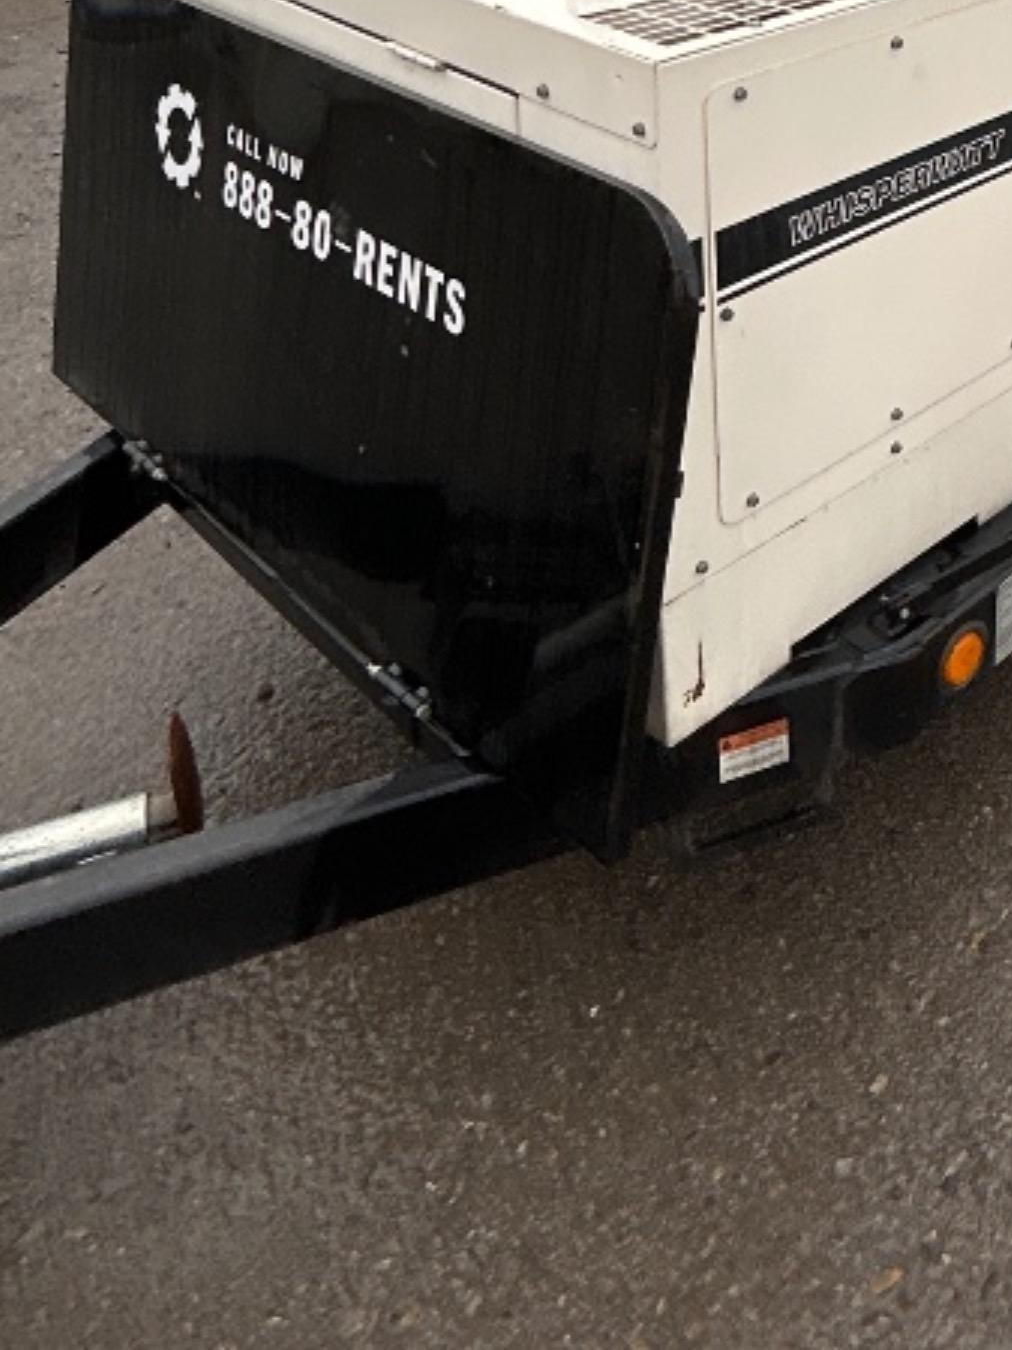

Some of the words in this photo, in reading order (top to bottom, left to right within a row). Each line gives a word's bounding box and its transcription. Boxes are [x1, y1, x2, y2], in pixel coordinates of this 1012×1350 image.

[226, 122, 262, 162] CALL
[266, 144, 305, 181] NOW
[787, 128, 1007, 248] WHISPERWATT
[221, 160, 467, 337] 888-80-RENTS
